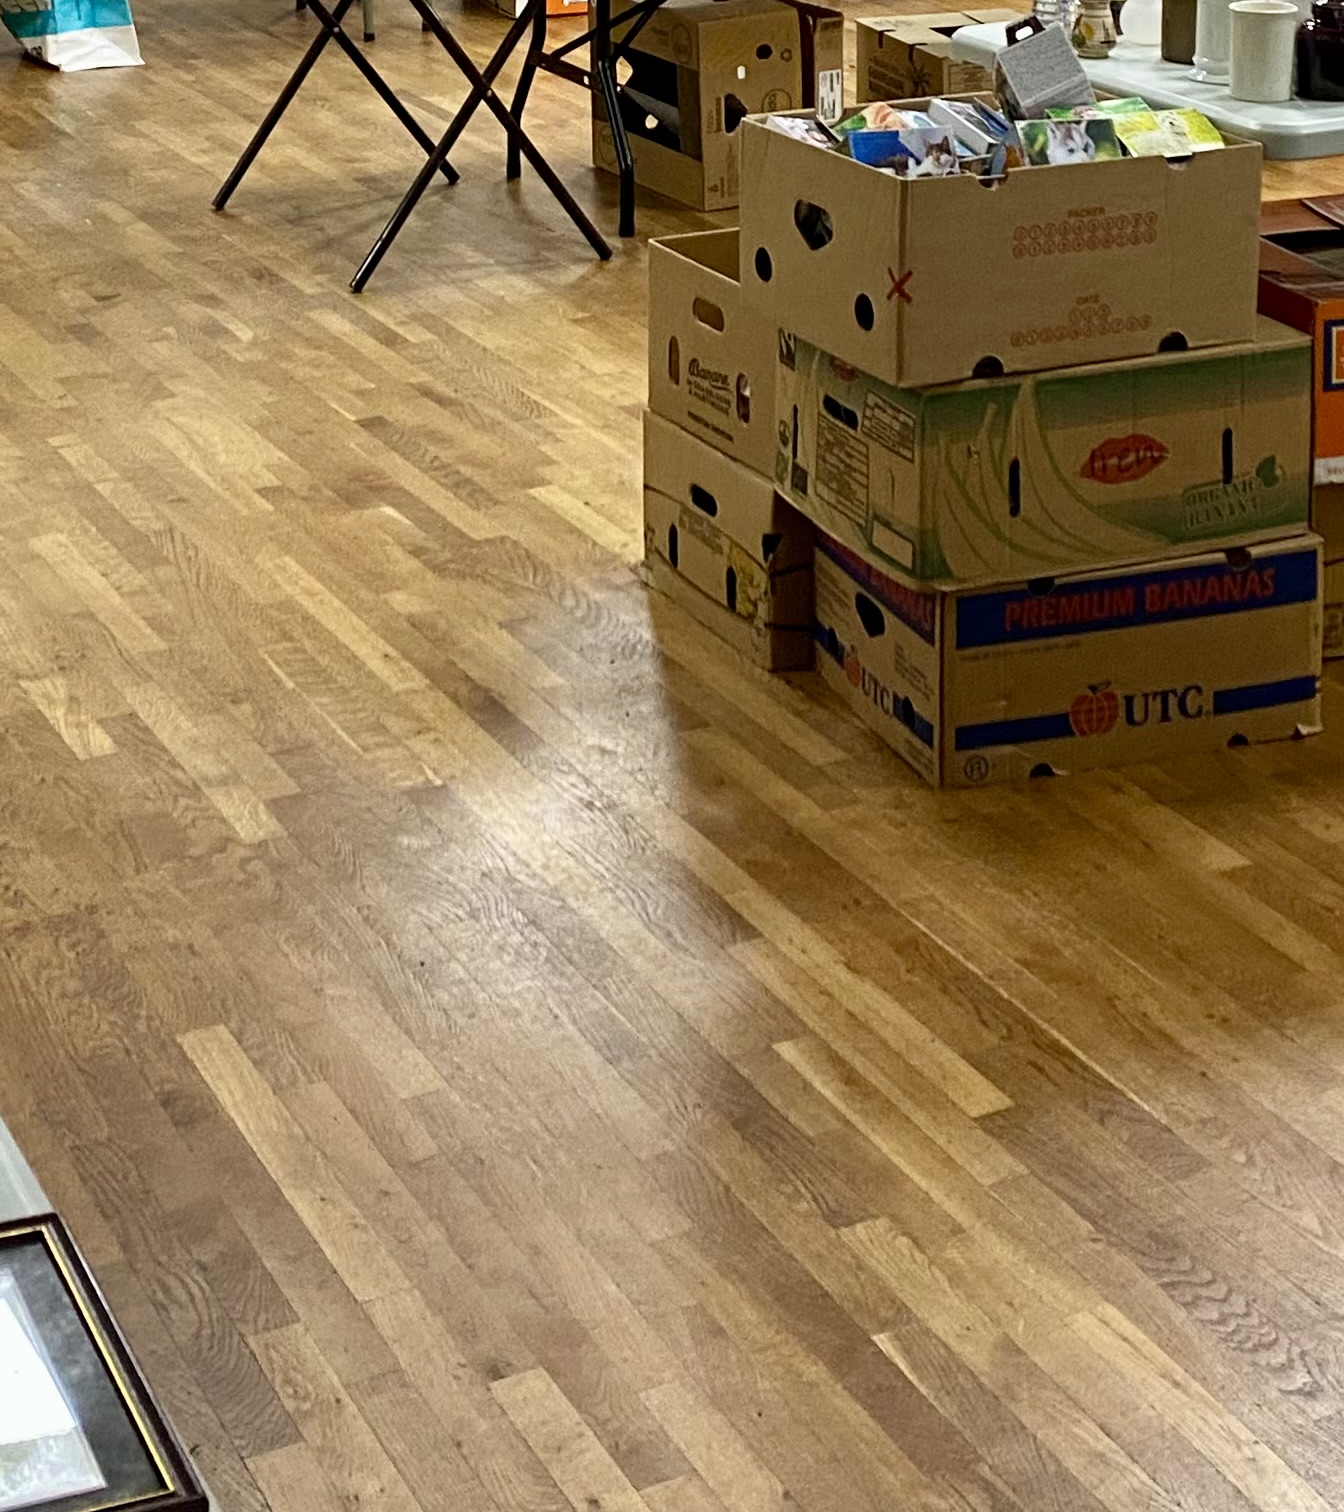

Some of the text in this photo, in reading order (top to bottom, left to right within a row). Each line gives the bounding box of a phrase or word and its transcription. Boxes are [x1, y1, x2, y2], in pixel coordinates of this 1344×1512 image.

[1004, 567, 1276, 632] PREMIUM BANANAS
[861, 666, 890, 715] UTC
[1122, 685, 1205, 728] UTC
